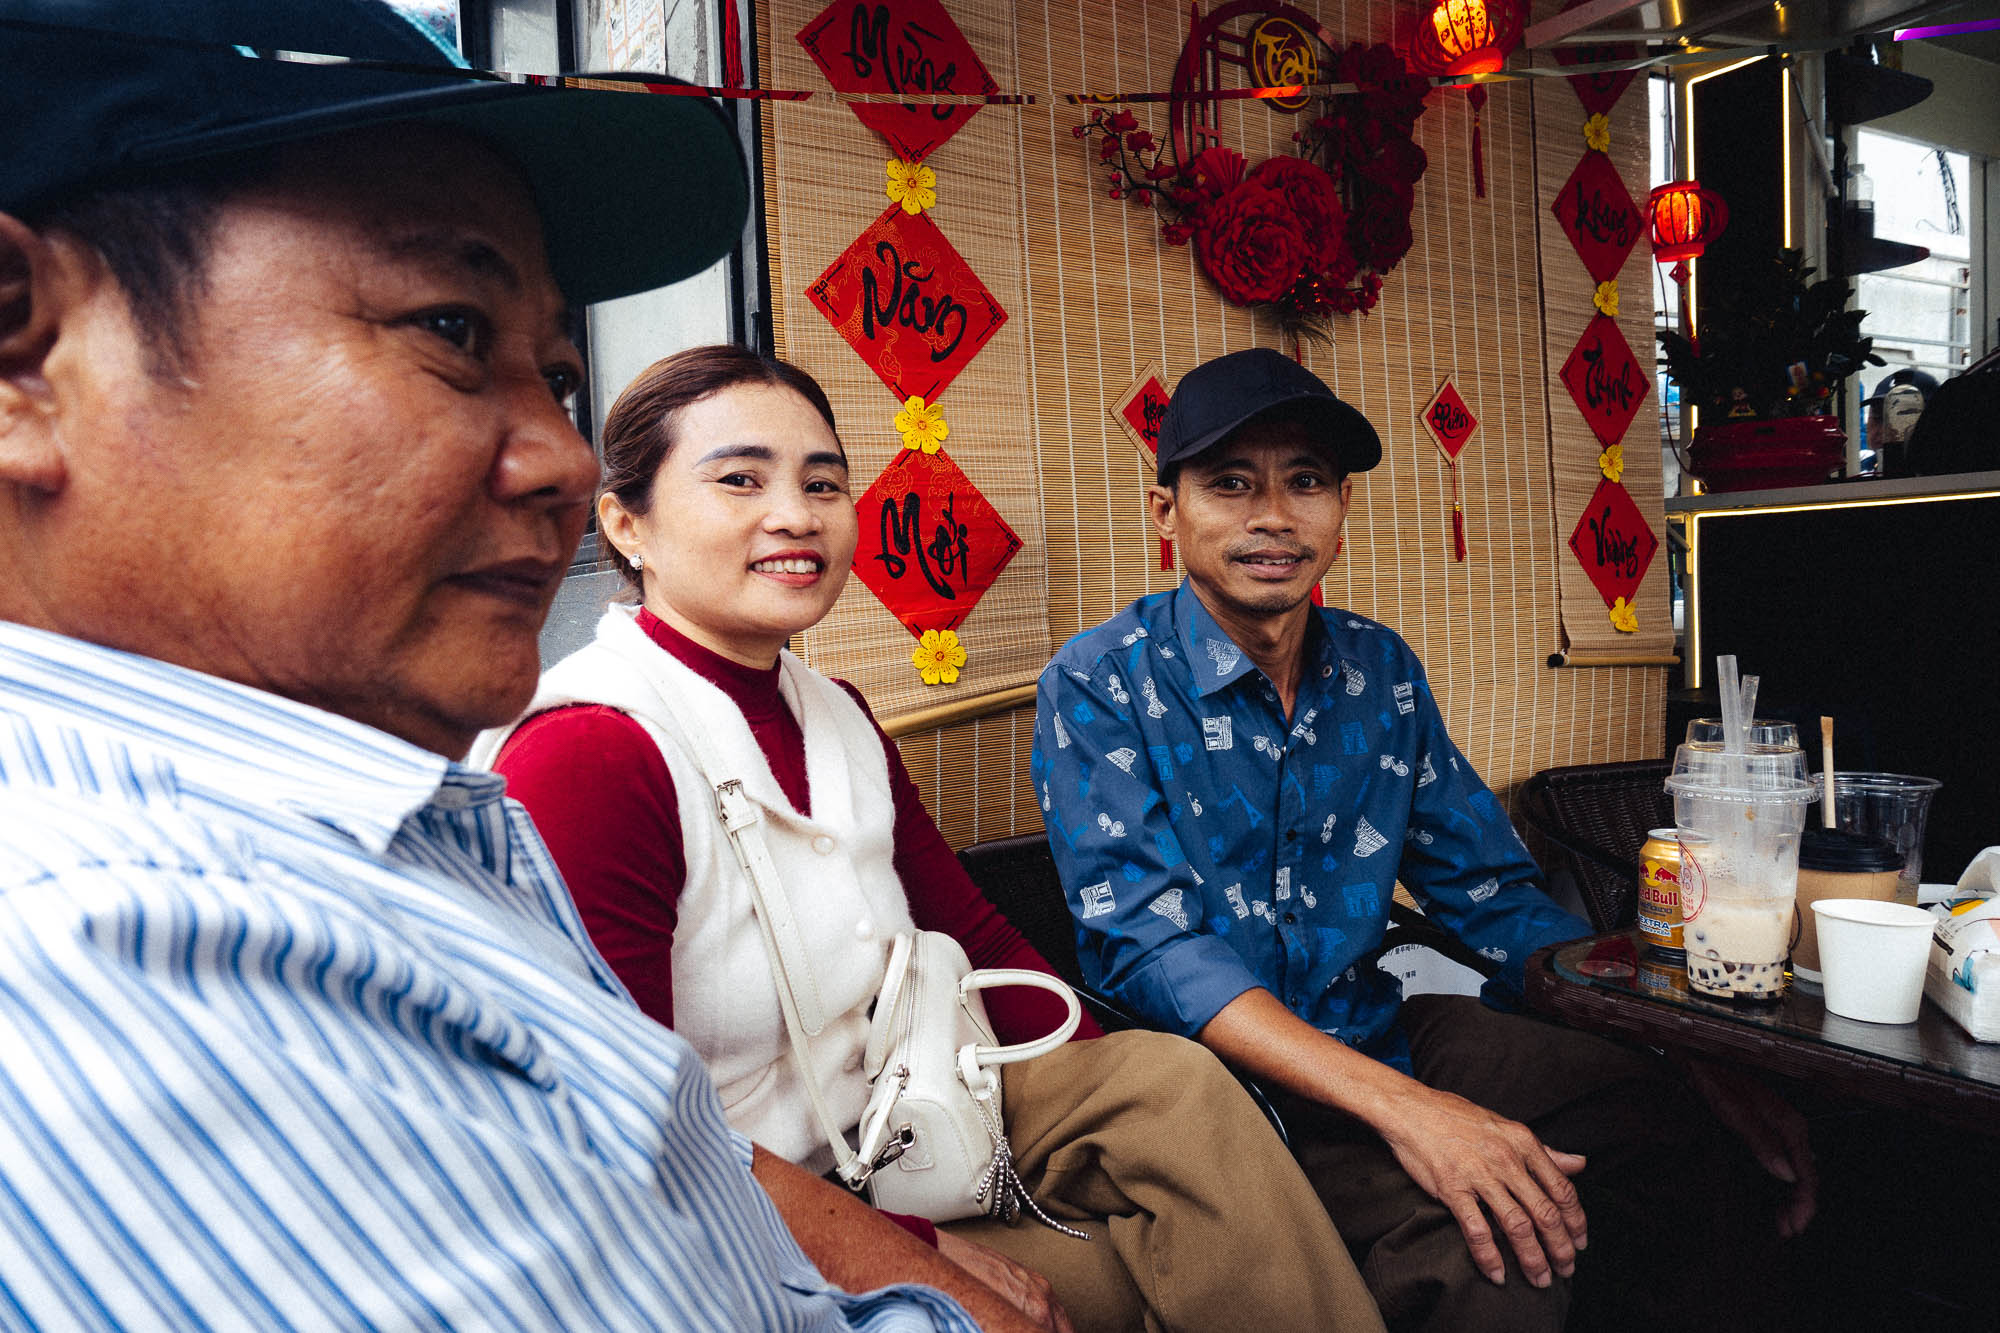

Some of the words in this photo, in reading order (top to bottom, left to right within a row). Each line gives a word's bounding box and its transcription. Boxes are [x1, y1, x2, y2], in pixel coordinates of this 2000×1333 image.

[841, 3, 957, 120] Mừng
[862, 241, 968, 362] Năm
[874, 491, 969, 601] Mới
[1652, 889, 1678, 906] Bull
